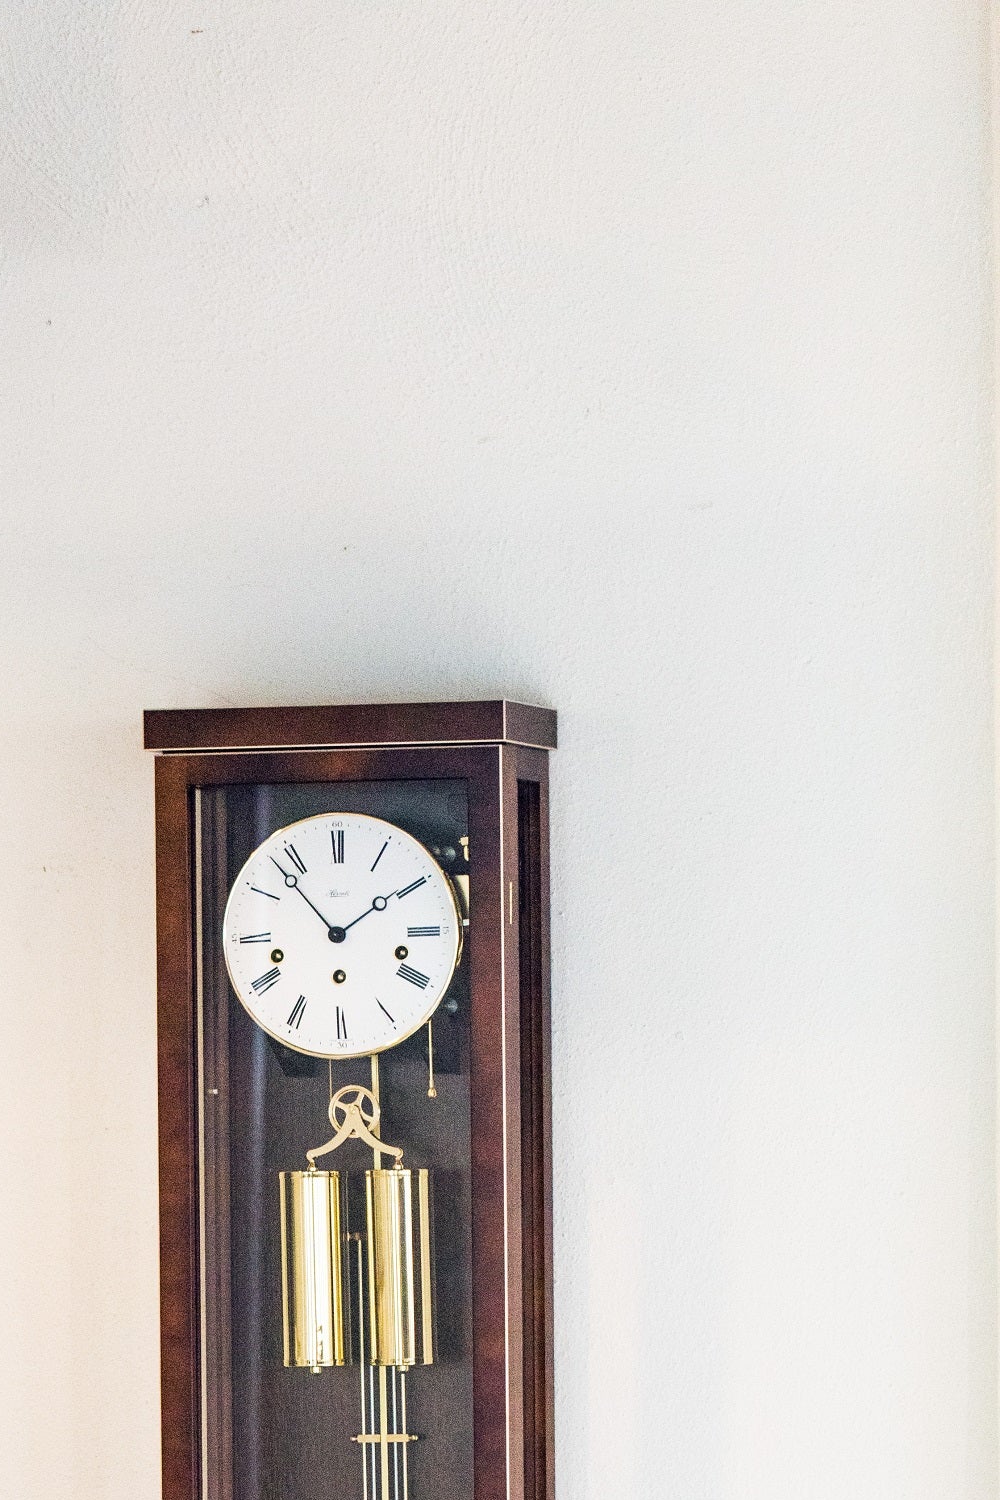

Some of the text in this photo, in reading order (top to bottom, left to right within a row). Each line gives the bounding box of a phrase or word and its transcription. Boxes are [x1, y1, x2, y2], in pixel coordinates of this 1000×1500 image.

[370, 841, 389, 872] I
[396, 876, 427, 899] II
[407, 926, 440, 937] III
[251, 966, 282, 997] VIII
[396, 963, 430, 990] IIII
[287, 995, 308, 1029] VII
